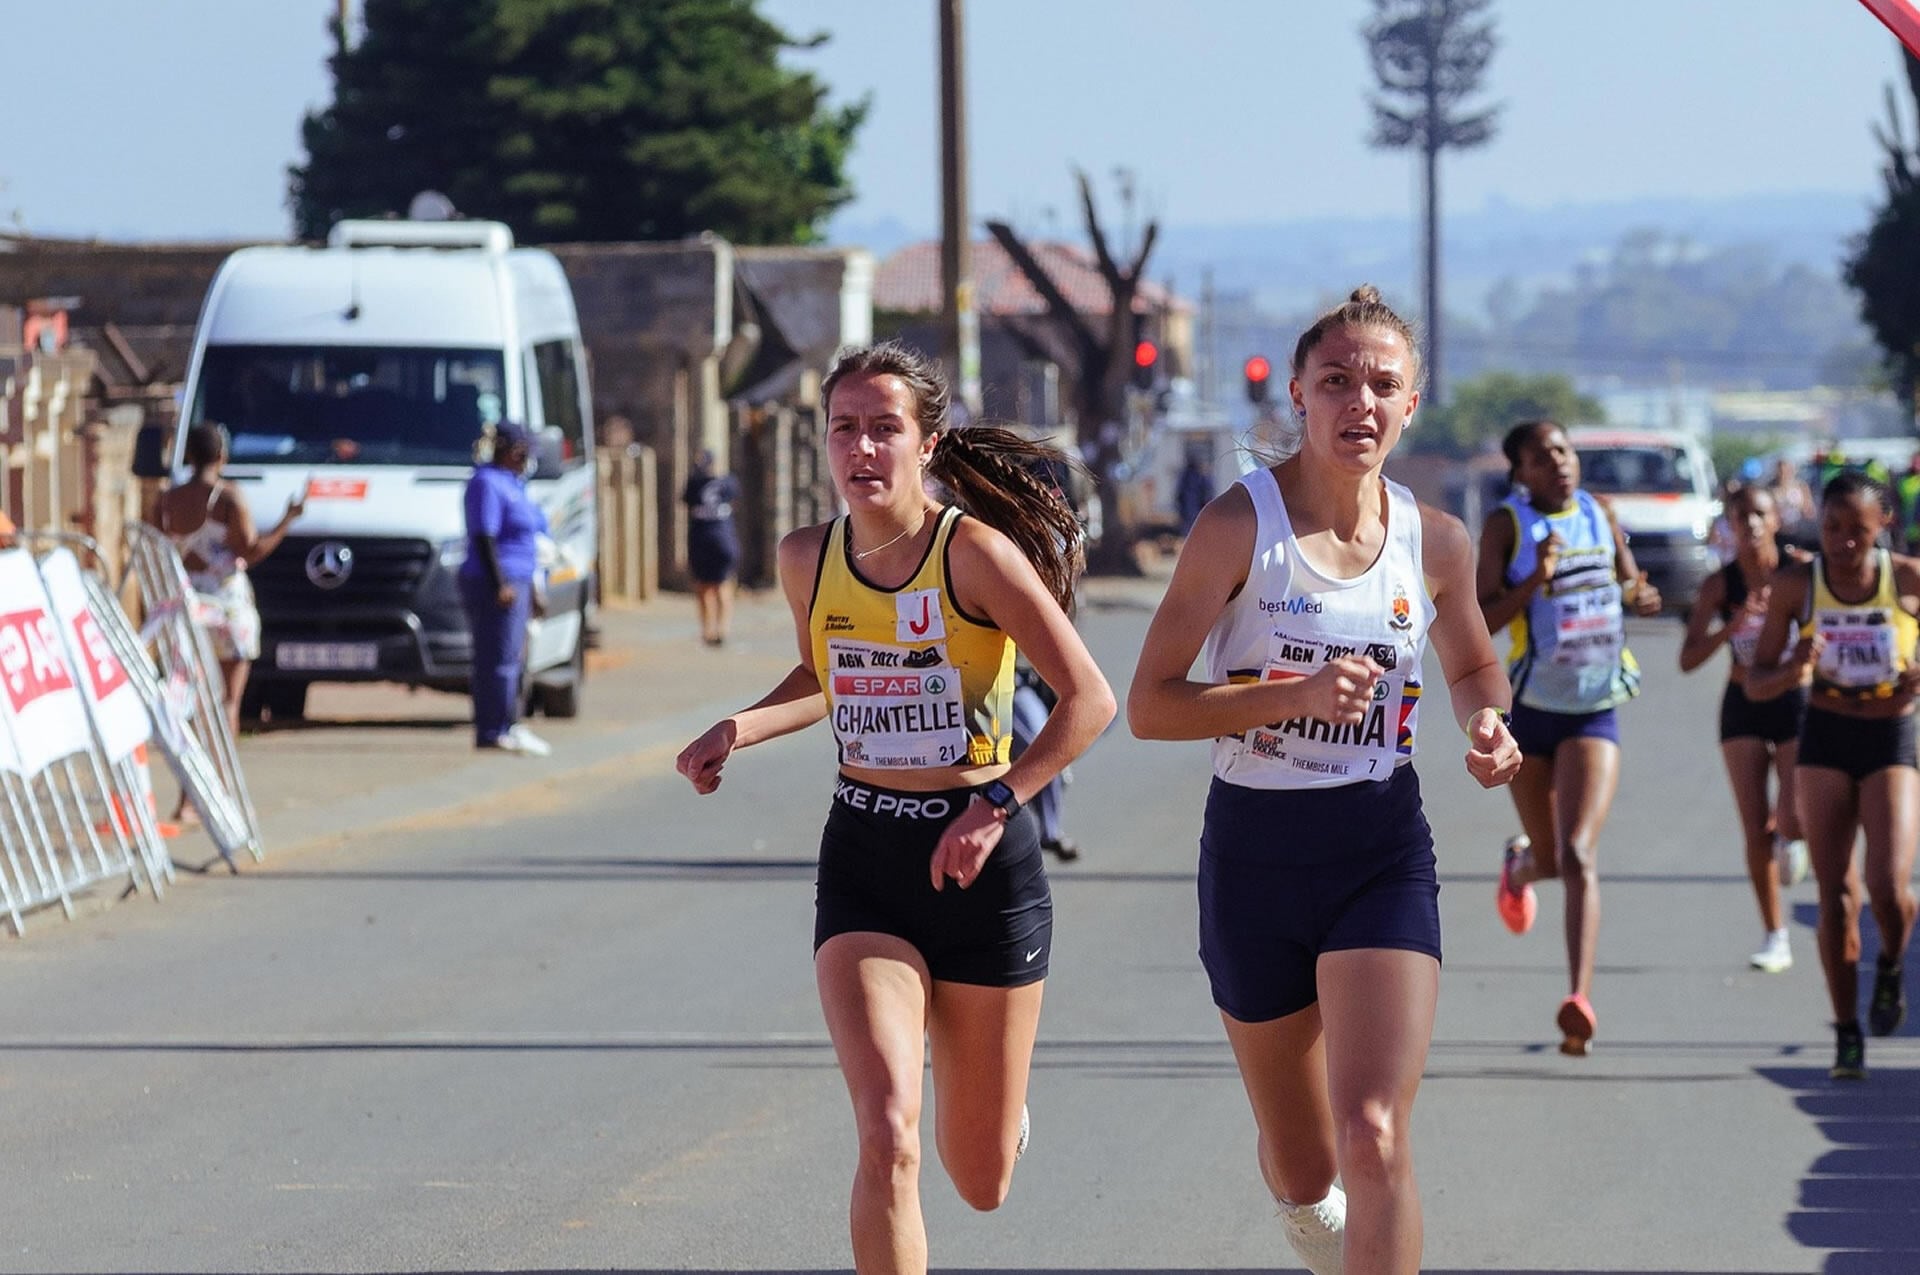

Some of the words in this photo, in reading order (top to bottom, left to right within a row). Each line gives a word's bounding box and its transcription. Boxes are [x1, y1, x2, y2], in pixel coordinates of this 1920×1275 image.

[909, 595, 930, 635] J
[1258, 597, 1323, 615] bestMed
[1280, 643, 1315, 664] AGN
[853, 679, 920, 694] SPAR
[836, 701, 961, 735] CHANTELLE
[875, 756, 909, 766] THEMBISA
[910, 756, 927, 766] MILE
[939, 744, 956, 762] 21
[1292, 757, 1330, 775] THEMBISA
[1330, 763, 1349, 775] MILE
[1368, 758, 1378, 774] 7
[873, 794, 951, 819] PRO
